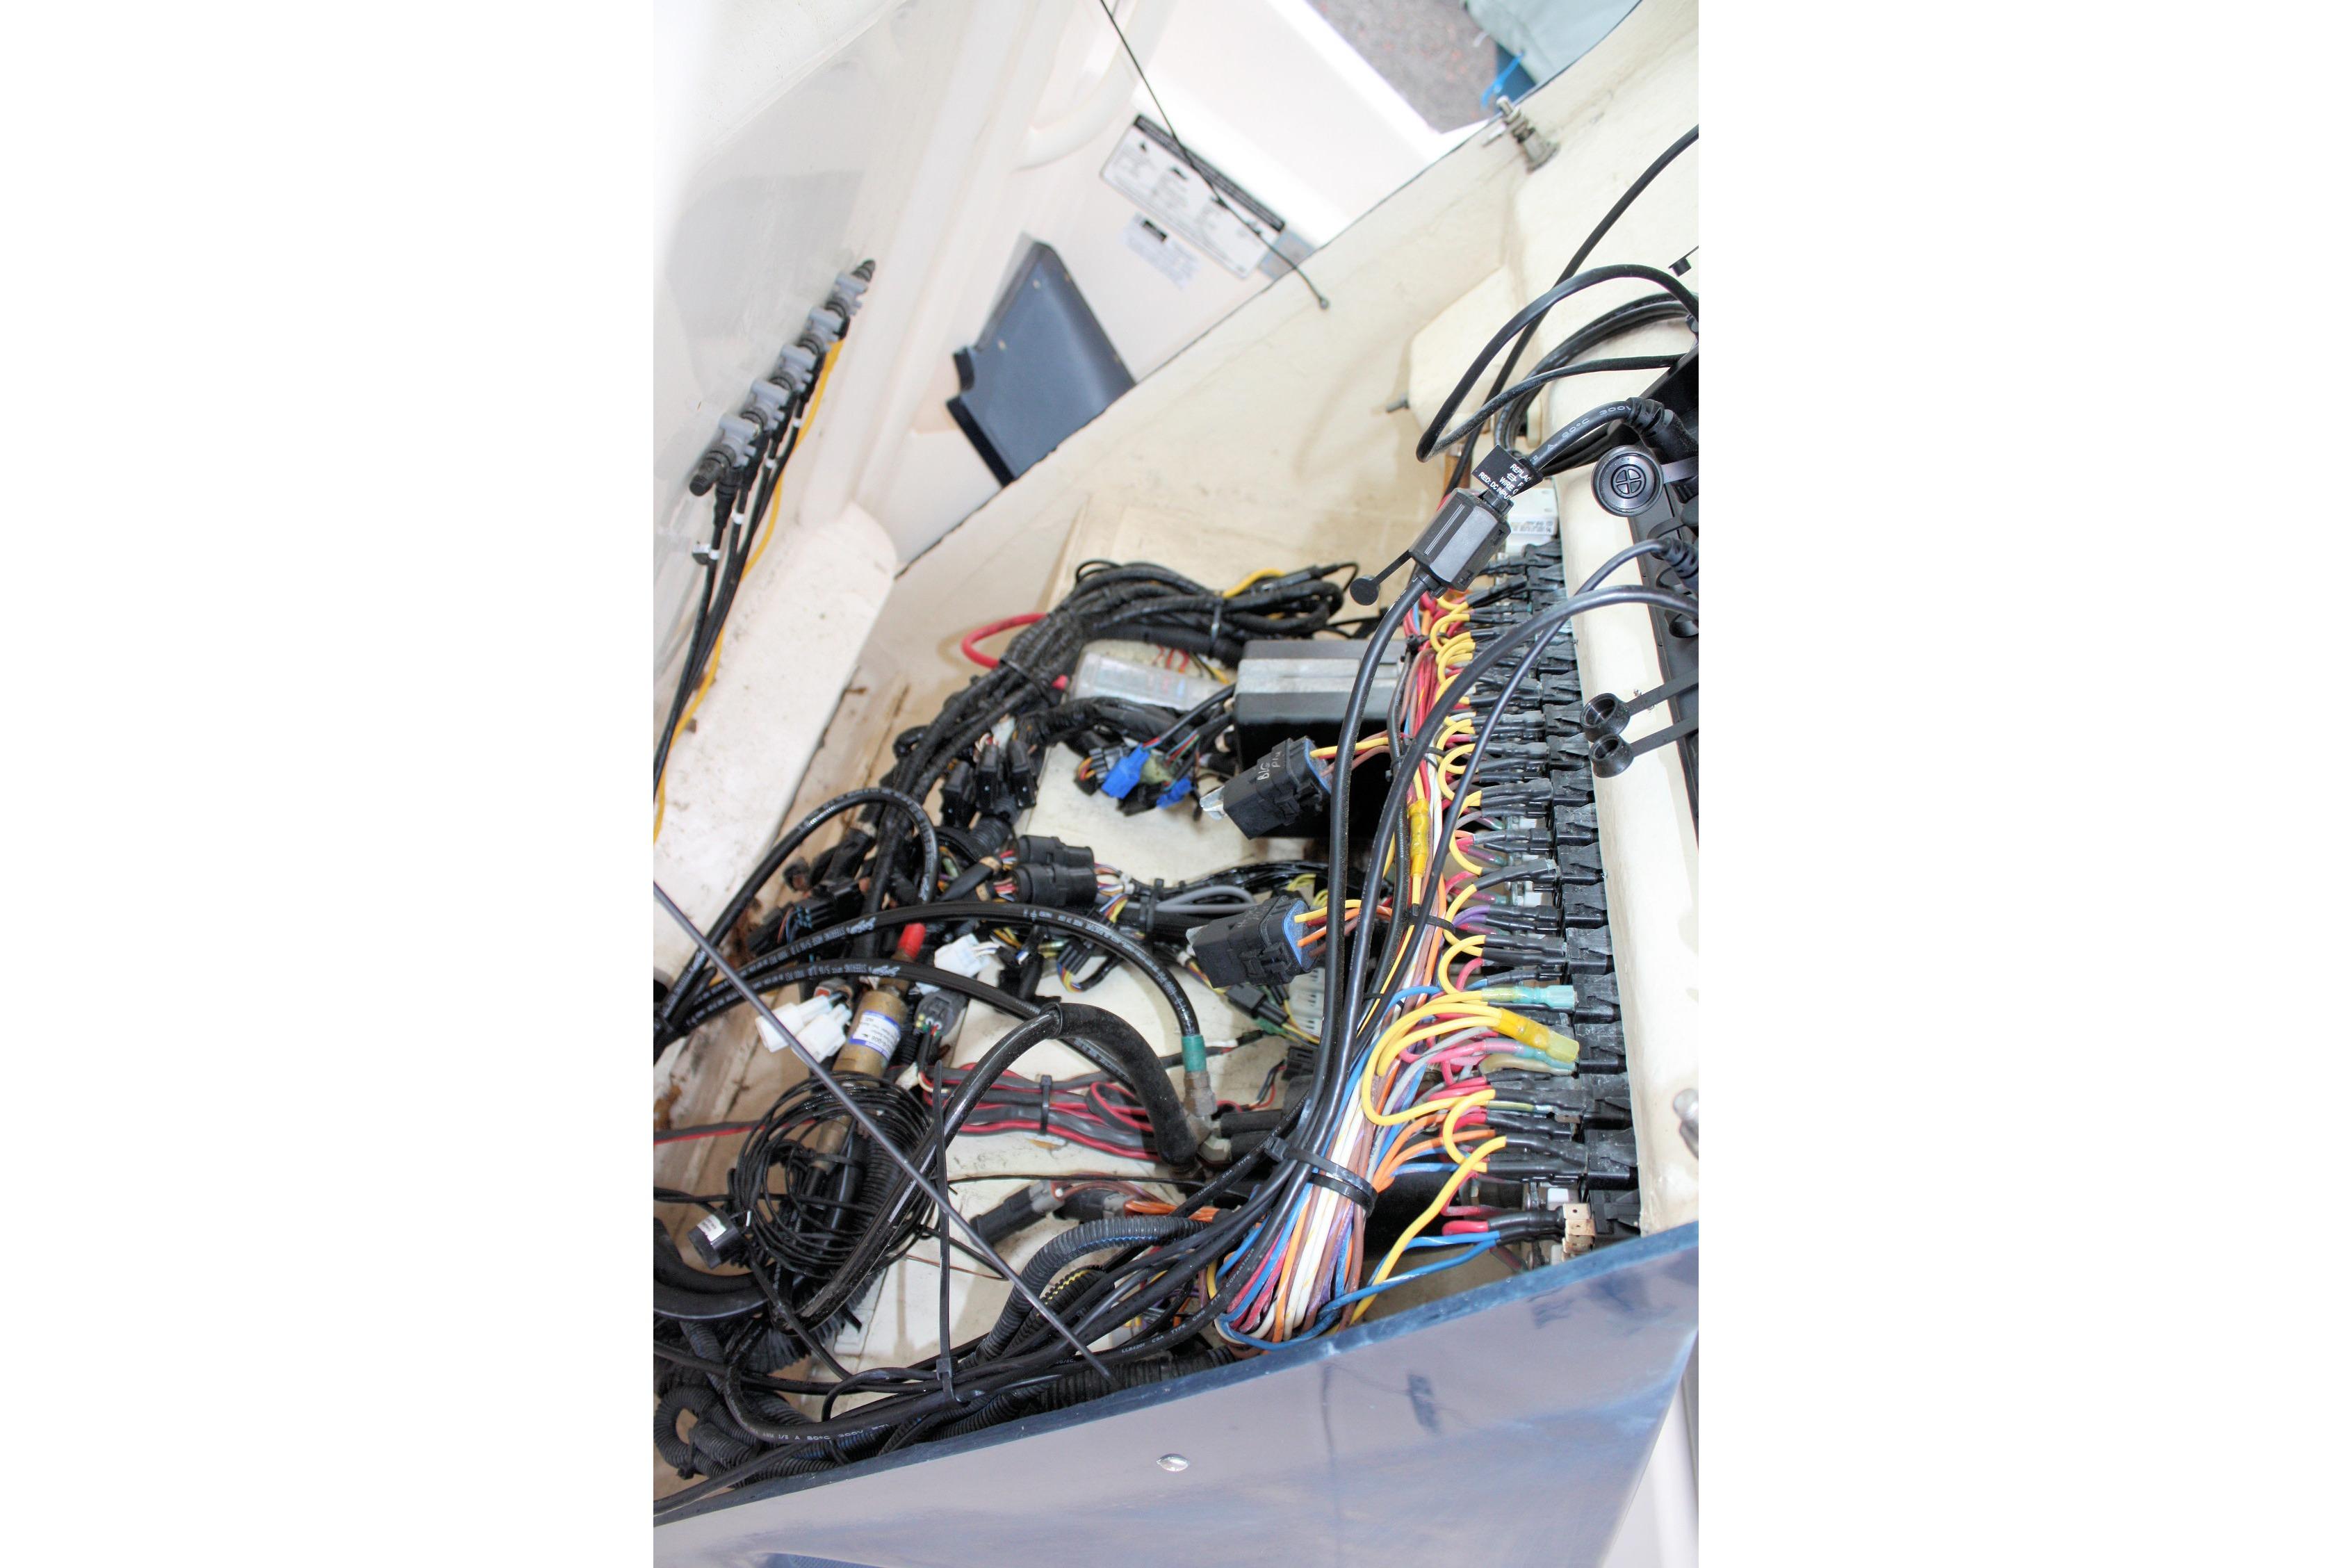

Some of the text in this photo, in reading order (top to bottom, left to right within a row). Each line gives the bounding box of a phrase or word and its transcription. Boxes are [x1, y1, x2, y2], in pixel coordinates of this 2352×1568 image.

[1478, 472, 1492, 484] RED:
[1499, 477, 1515, 491] WIRE
[1152, 1334, 1164, 1343] CSA
[1170, 1323, 1187, 1334] TYPE
